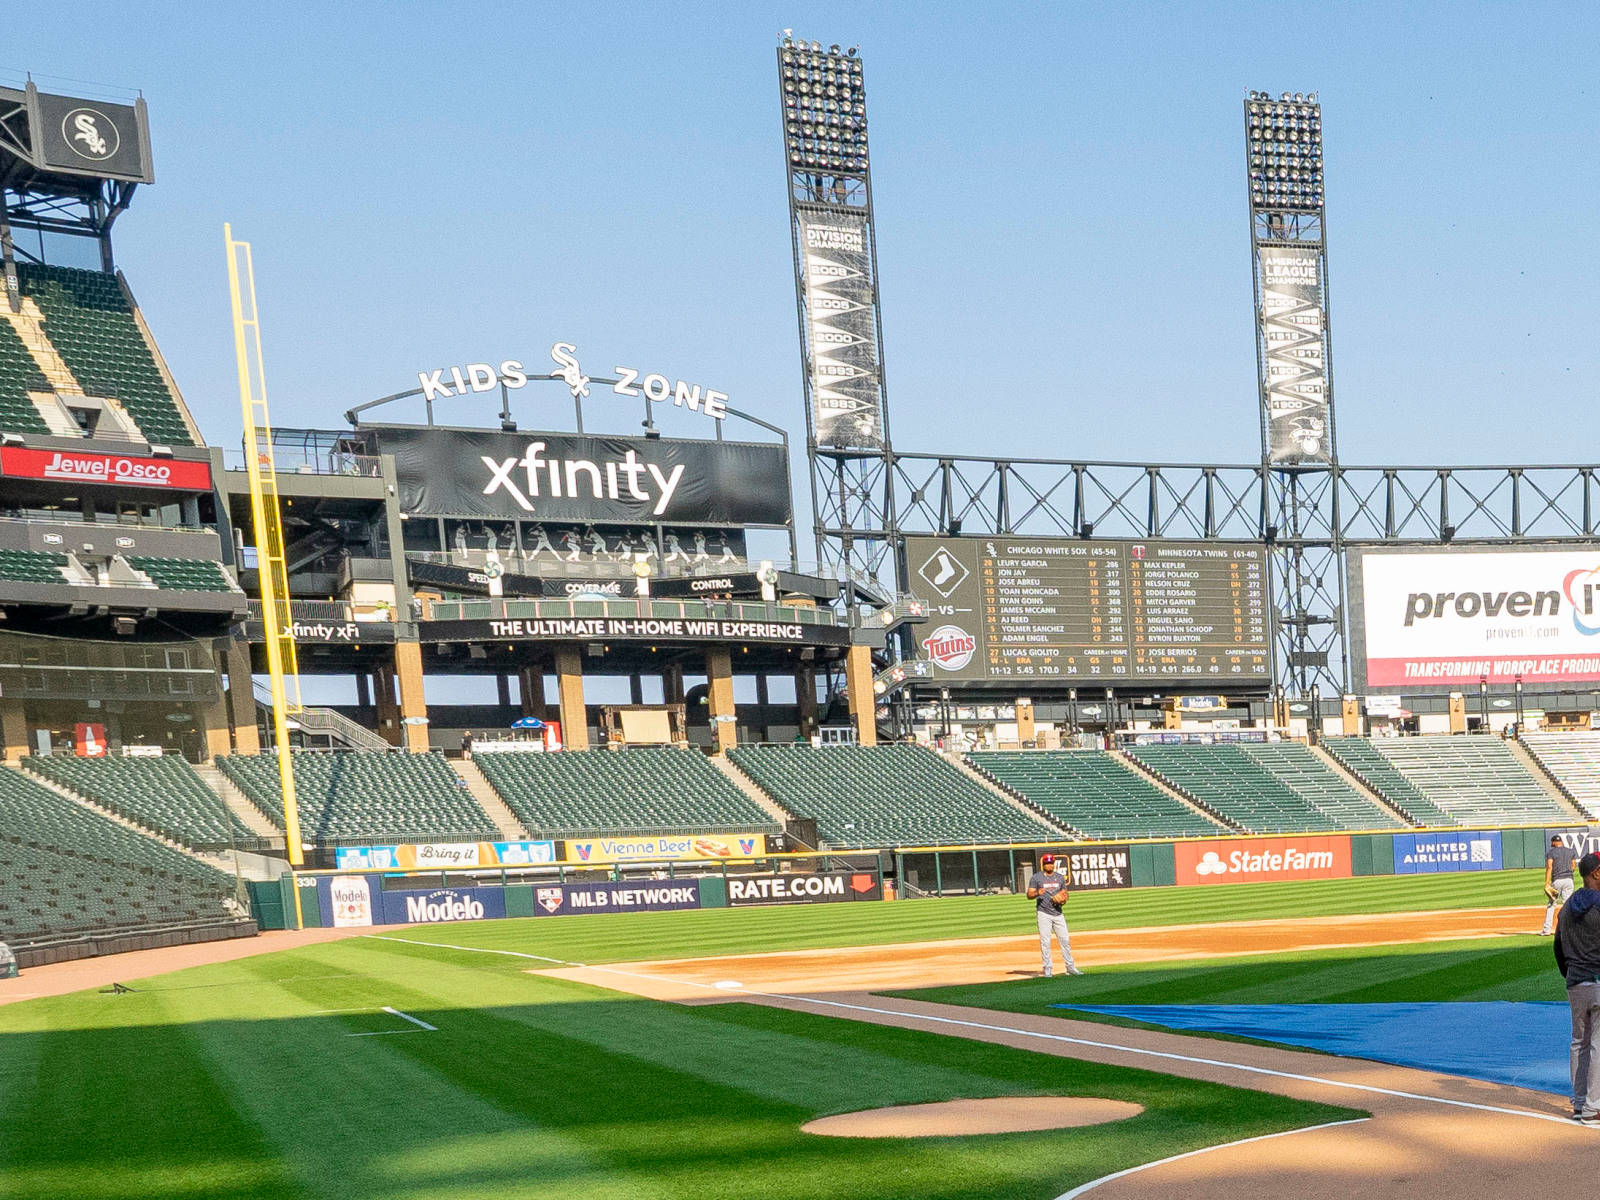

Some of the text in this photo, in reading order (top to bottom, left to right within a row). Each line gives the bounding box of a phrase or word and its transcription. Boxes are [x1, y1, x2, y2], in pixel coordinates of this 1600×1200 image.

[807, 230, 862, 244] DIVISION
[808, 240, 862, 252] CHAMPIONS
[1265, 257, 1315, 266] AMERICAN
[1266, 265, 1316, 277] LEAGUE
[1266, 276, 1317, 285] CHAMPIONS
[417, 360, 528, 401] KIDS
[613, 365, 729, 420] ZONE
[44, 453, 171, 484] Jewel-Osco
[481, 442, 685, 515] xfinity
[1007, 546, 1043, 554] CHICAGO
[1091, 548, 1116, 556] (45-54)
[1204, 550, 1227, 558] TWINS
[565, 581, 621, 595] COVERAGE
[691, 579, 733, 591] CONTROL
[938, 605, 954, 615] VS
[1404, 588, 1561, 627] proven
[283, 621, 359, 640] xfinity xFi
[489, 620, 803, 639] THE ULTIMATE IN-HOME WIFI EXPERIENCE
[922, 636, 976, 660] Twins
[1017, 666, 1033, 674] 5.45
[1039, 666, 1059, 674] 170.0
[1405, 661, 1490, 677] TRANSFORMING
[1493, 659, 1561, 675] WORKPLACE
[420, 845, 474, 862] Bring it
[601, 839, 692, 855] Vienna Beef
[1416, 843, 1468, 853] UNITED
[1071, 853, 1126, 869] STREAM
[1229, 849, 1333, 873] StateFarm
[1403, 852, 1468, 863] AIRLINES
[297, 877, 317, 887] 330
[1072, 870, 1108, 885] YOUR
[729, 875, 845, 899] RATE.COM
[334, 890, 368, 903] Modelo
[571, 888, 696, 907] MLB NETWORK
[407, 895, 483, 923] Modelo
